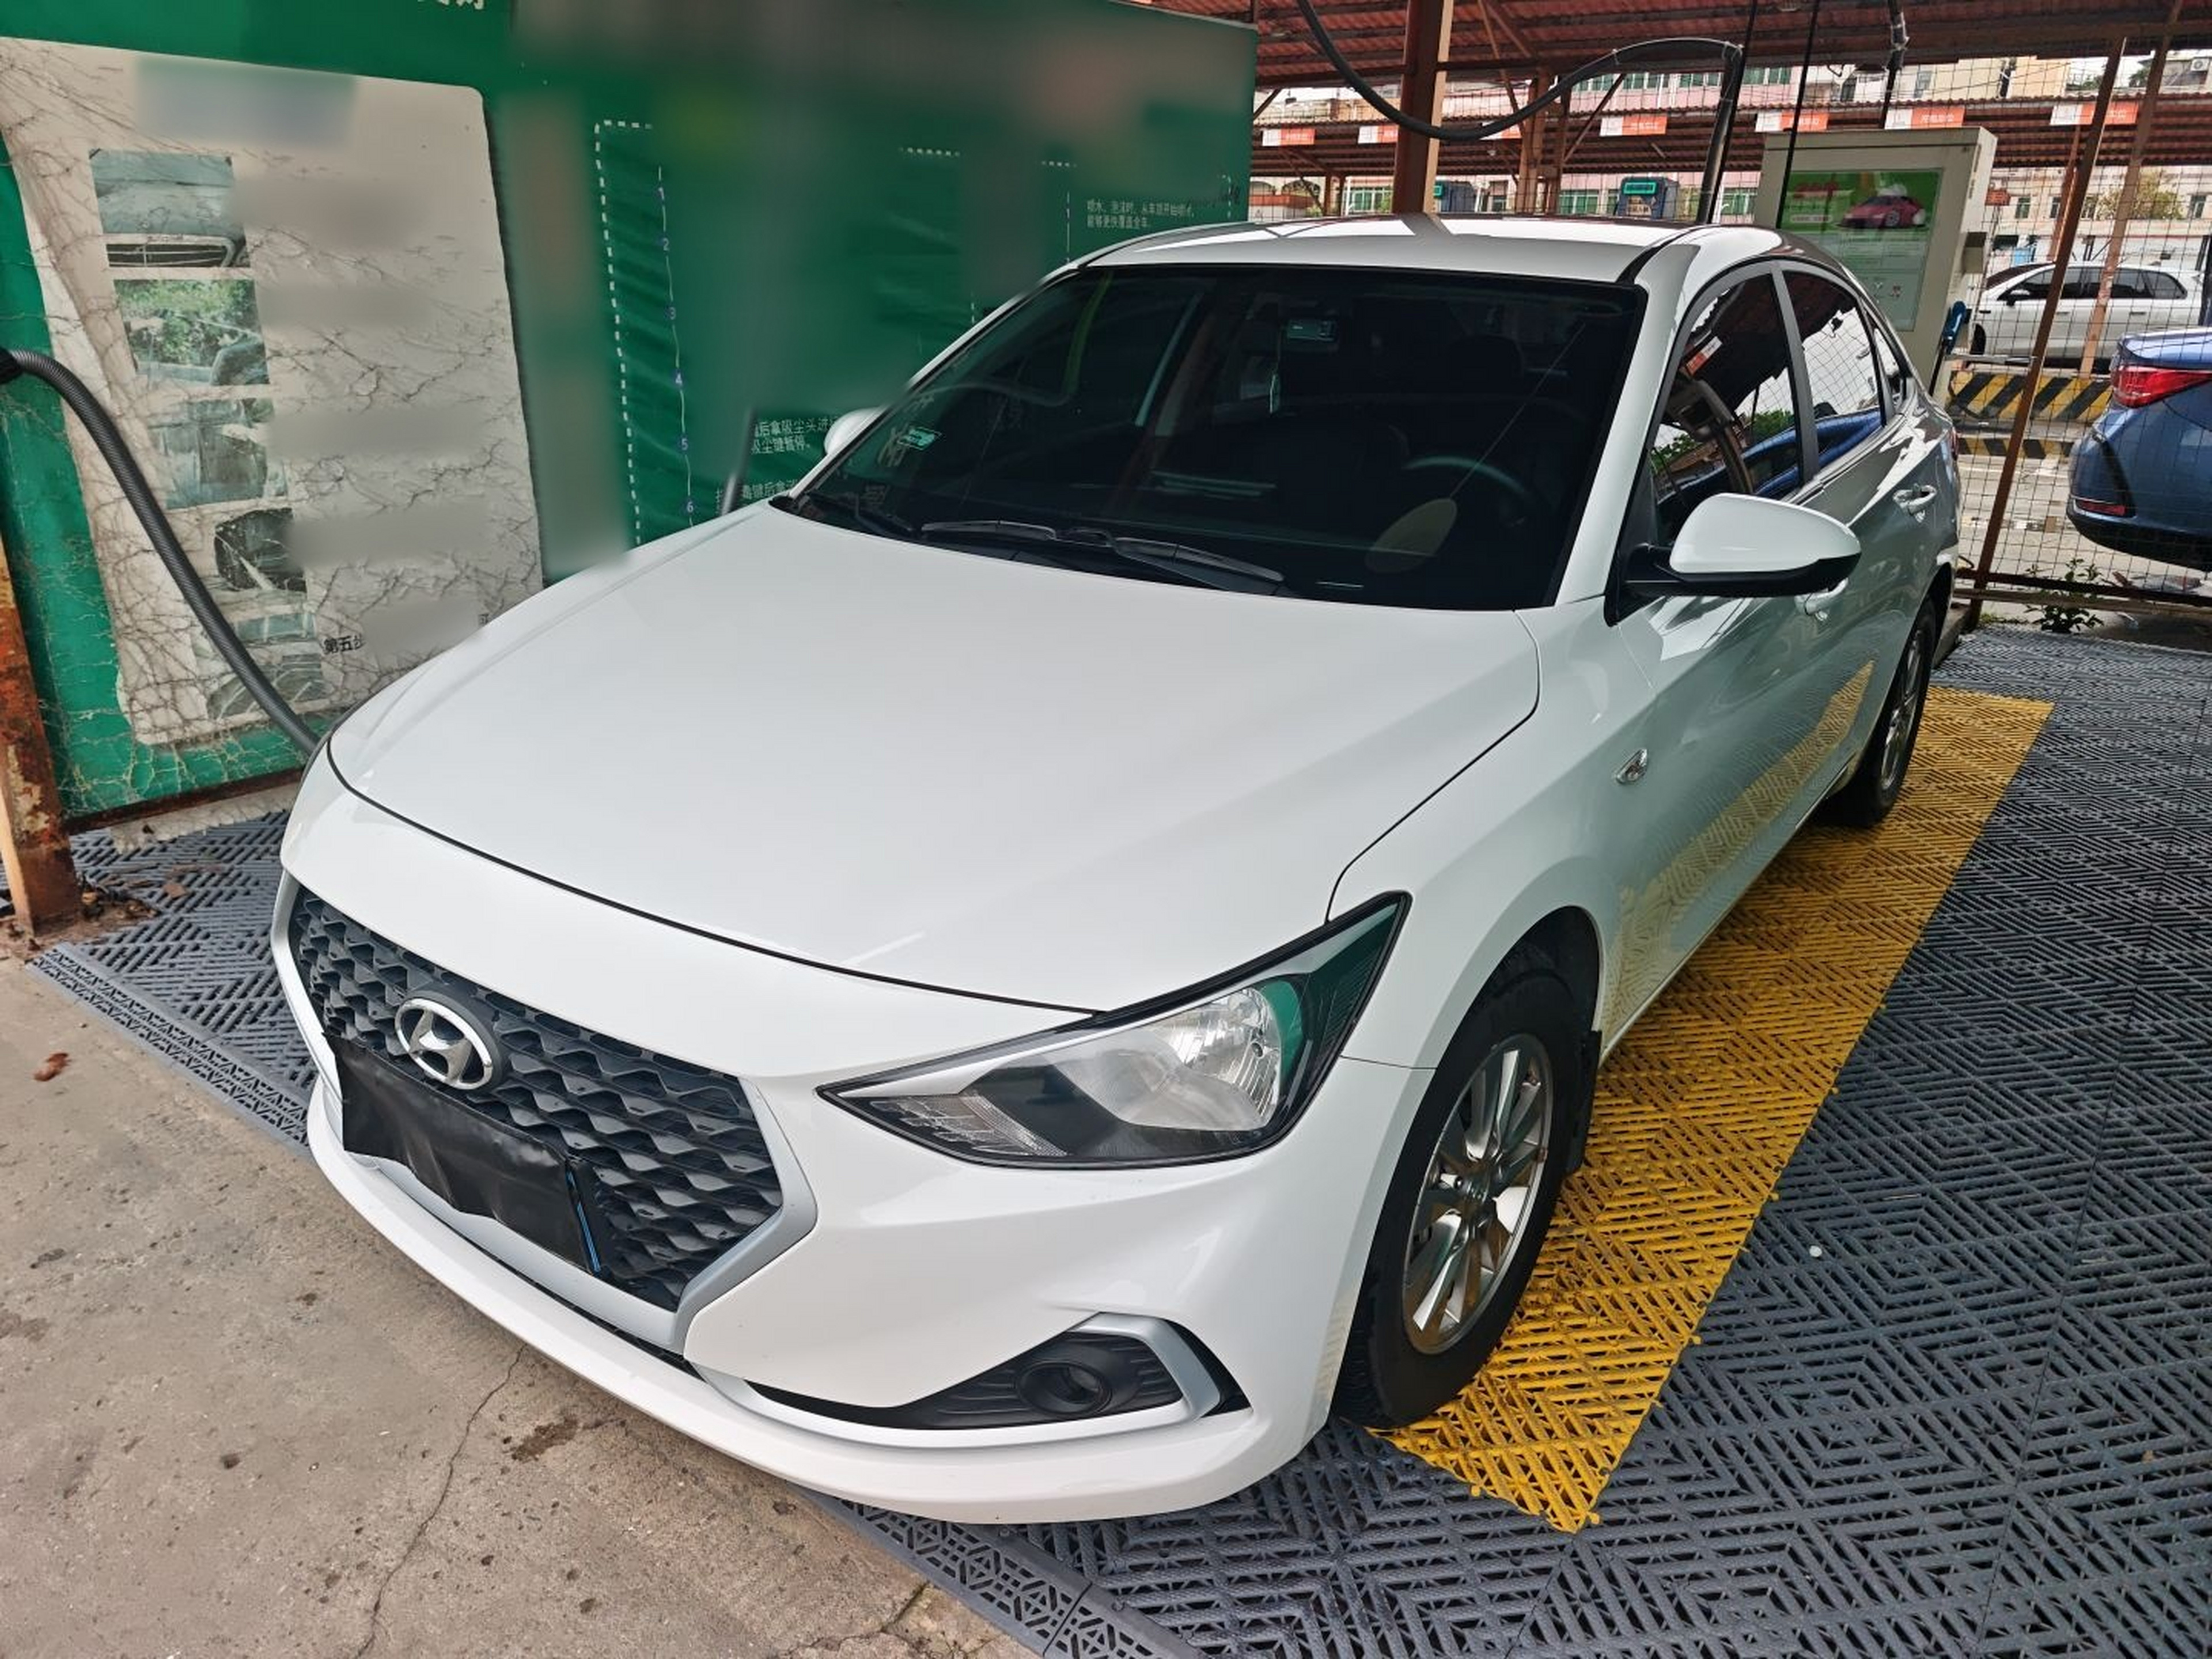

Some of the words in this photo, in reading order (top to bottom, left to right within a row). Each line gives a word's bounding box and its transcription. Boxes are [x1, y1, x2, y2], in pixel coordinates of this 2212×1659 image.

[658, 187, 665, 200] 1
[663, 237, 669, 251] 2
[669, 306, 676, 320] 3
[675, 373, 683, 387] 4
[681, 438, 688, 451] 5
[687, 501, 694, 513] 6
